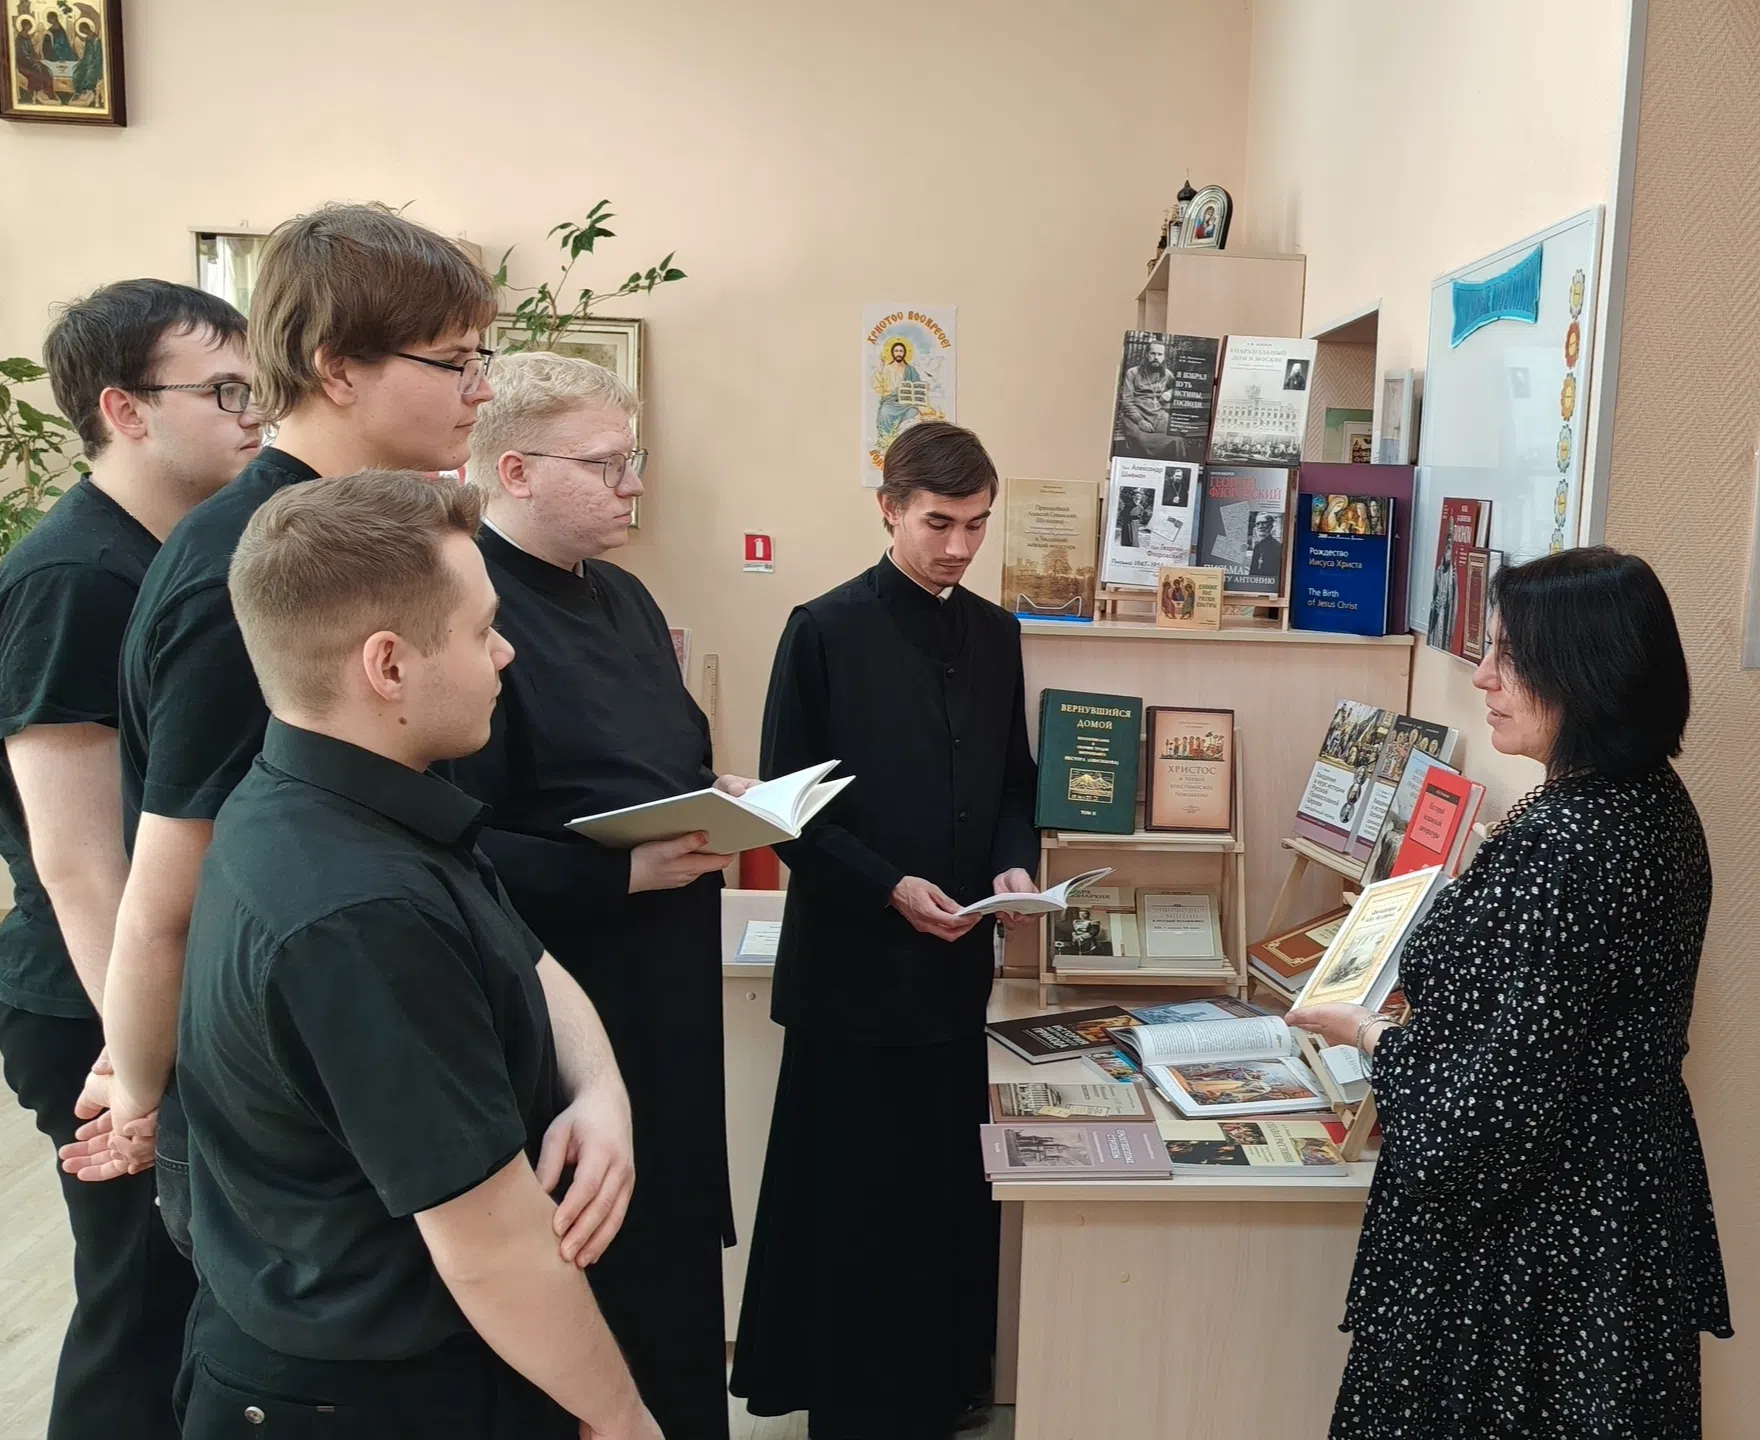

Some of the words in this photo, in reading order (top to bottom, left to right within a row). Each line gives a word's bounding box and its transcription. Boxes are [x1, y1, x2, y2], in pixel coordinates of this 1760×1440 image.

[1309, 547, 1349, 557] Рождество
[1308, 558, 1335, 568] Иисуса
[1336, 559, 1363, 569] Христа
[1233, 576, 1276, 585] АНТОНИЮ
[1308, 587, 1321, 597] The
[1322, 589, 1340, 598] Birth
[1307, 598, 1316, 606] of
[1317, 599, 1336, 608] Jesus
[1336, 600, 1358, 610] Christ
[1061, 703, 1132, 718] ВЕРНУВШИЙСЯ
[1076, 719, 1113, 730] ДОМОЙ
[1168, 764, 1217, 775] ХРИСТОС
